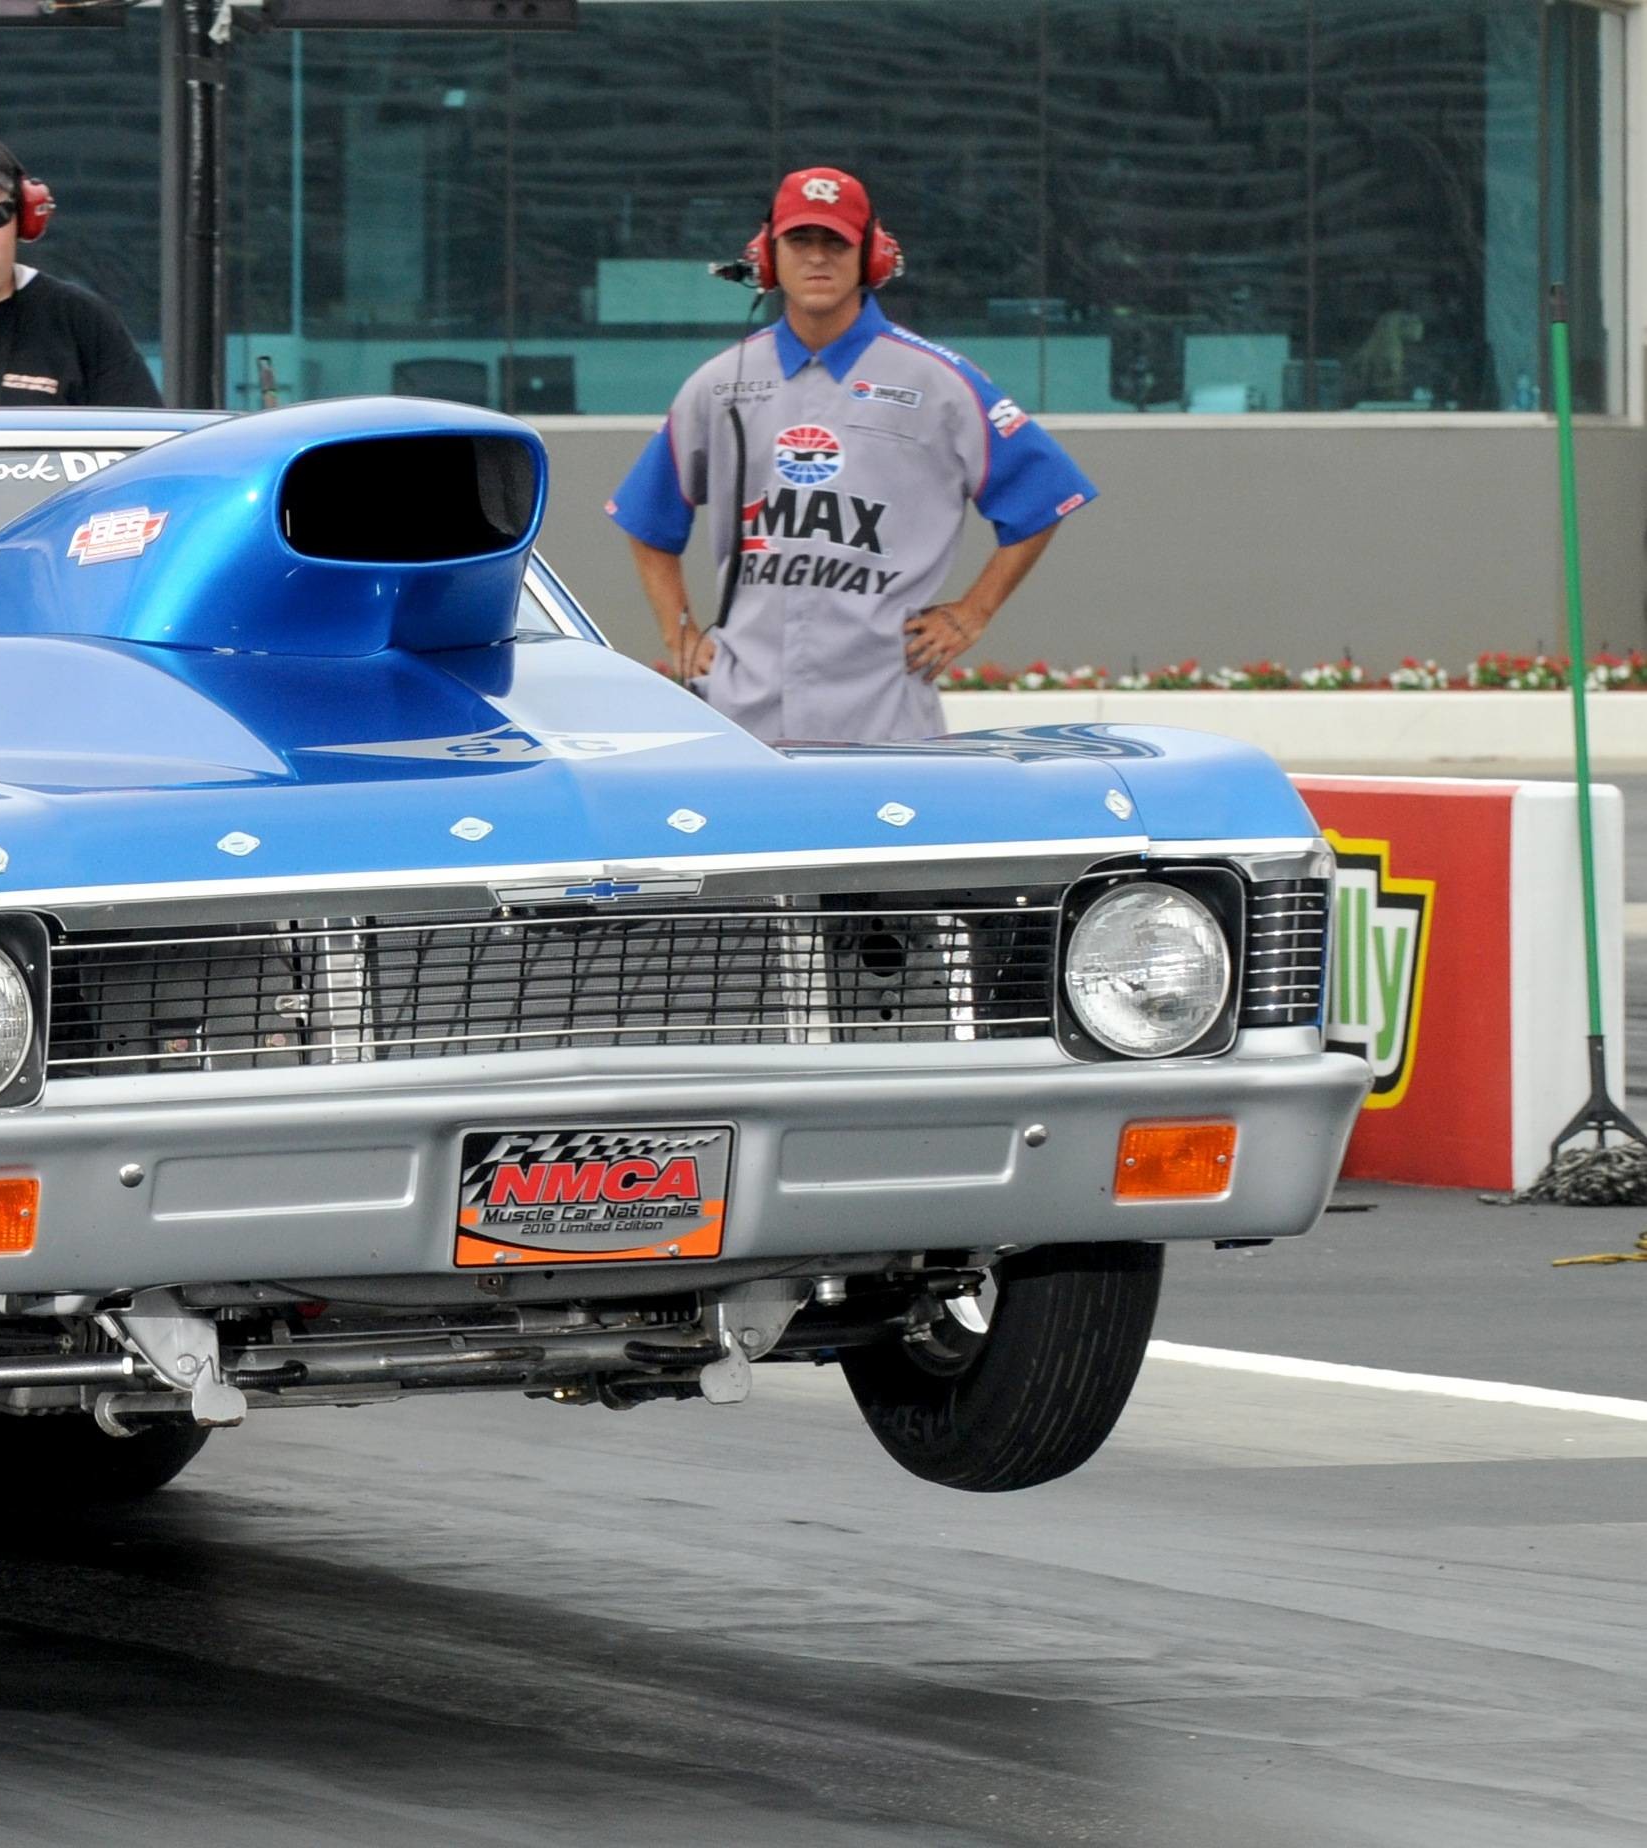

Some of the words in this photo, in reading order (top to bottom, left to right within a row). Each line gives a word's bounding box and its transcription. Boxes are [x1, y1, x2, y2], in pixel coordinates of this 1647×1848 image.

[89, 511, 147, 544] BES
[741, 553, 902, 595] RAGWAY
[1328, 886, 1408, 1061] lly
[486, 1157, 700, 1205] NMCA
[482, 1207, 555, 1224] Muscle
[560, 1205, 598, 1221] Car
[603, 1202, 700, 1219] Nationals
[520, 1223, 556, 1234] 2010
[559, 1221, 612, 1233] Limited
[615, 1219, 664, 1232] Edition
